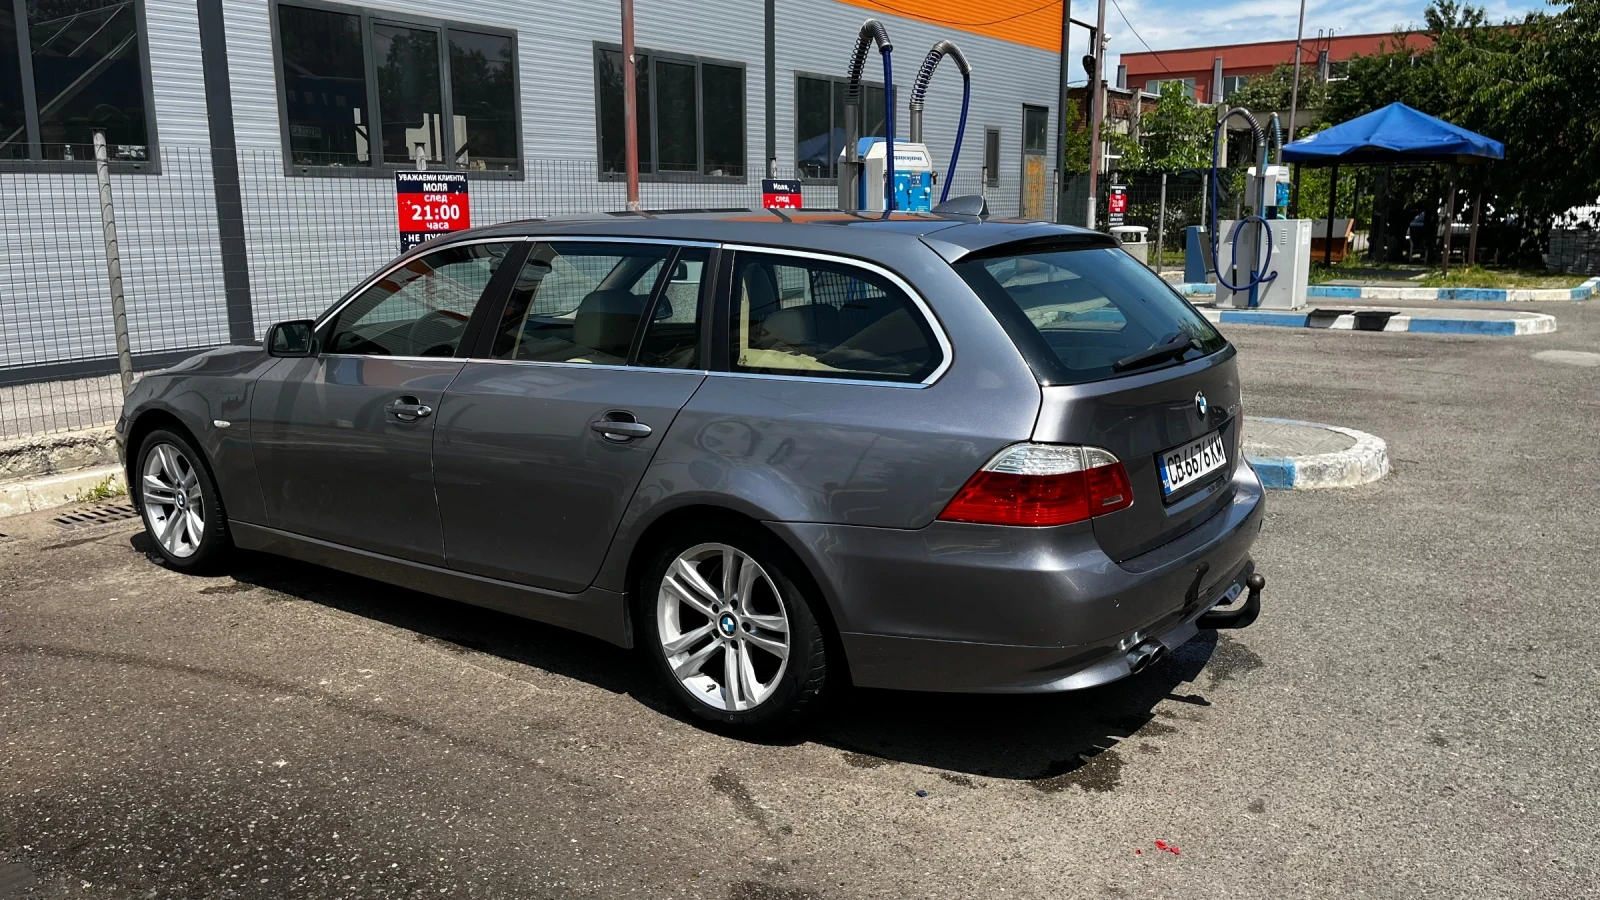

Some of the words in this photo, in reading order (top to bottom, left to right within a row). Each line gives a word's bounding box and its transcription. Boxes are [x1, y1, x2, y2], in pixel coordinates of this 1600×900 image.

[398, 173, 437, 181] УВАЖАЕМИ
[438, 174, 466, 182] КЛИЕНТИ,
[423, 183, 448, 192] МОЛЯ
[424, 194, 448, 203] след
[775, 195, 790, 203] след
[411, 205, 460, 220] 21:00
[426, 222, 449, 230] часа
[408, 233, 421, 242] НЕ
[1184, 441, 1211, 477] 6676
